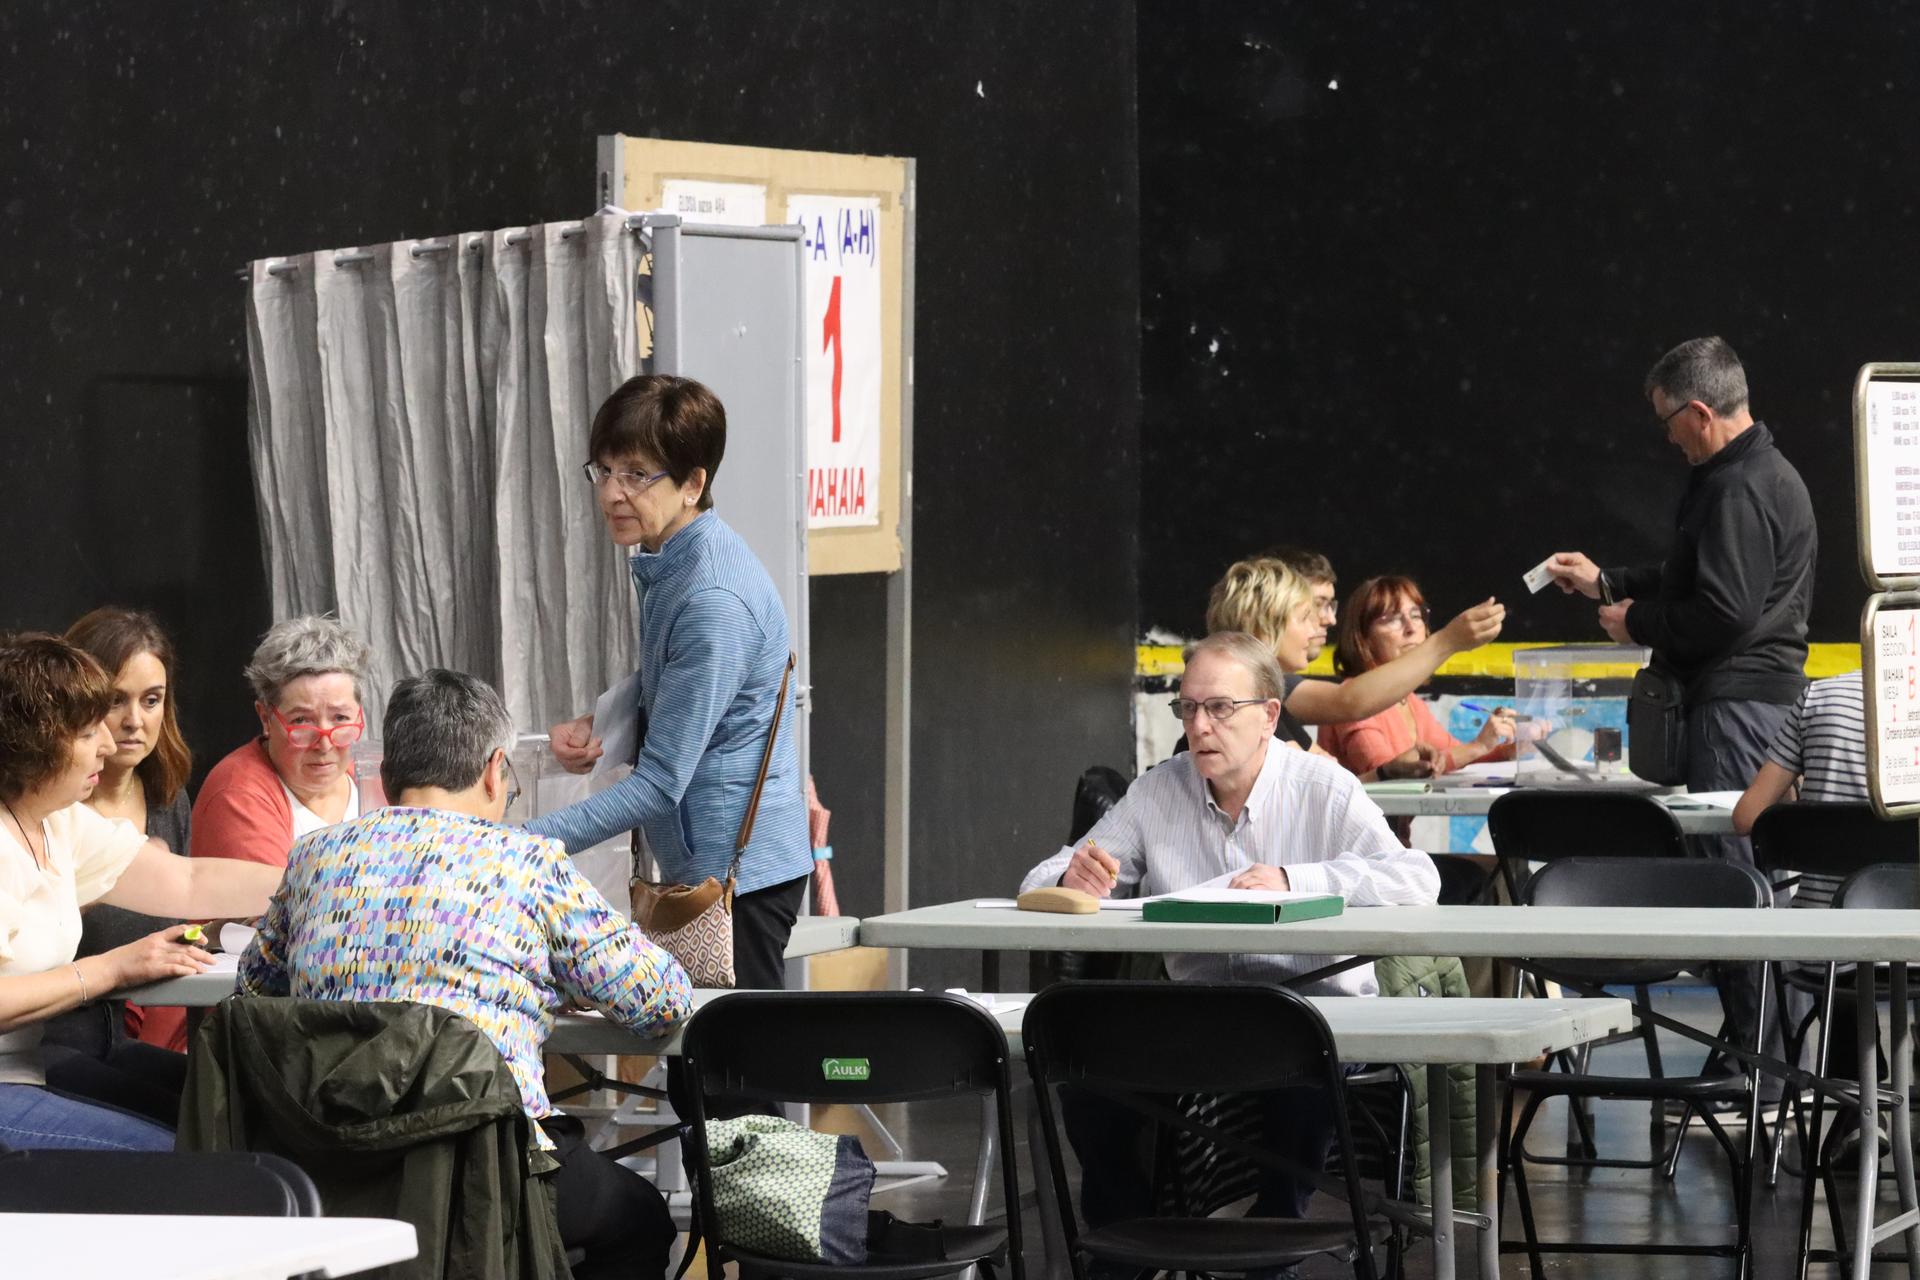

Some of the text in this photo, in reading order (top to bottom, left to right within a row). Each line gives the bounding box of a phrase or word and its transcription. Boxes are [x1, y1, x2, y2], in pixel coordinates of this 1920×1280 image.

[798, 215, 828, 261] -A
[823, 276, 842, 443] 1
[1908, 614, 1916, 656] 1
[831, 1065, 867, 1076] AULKI
